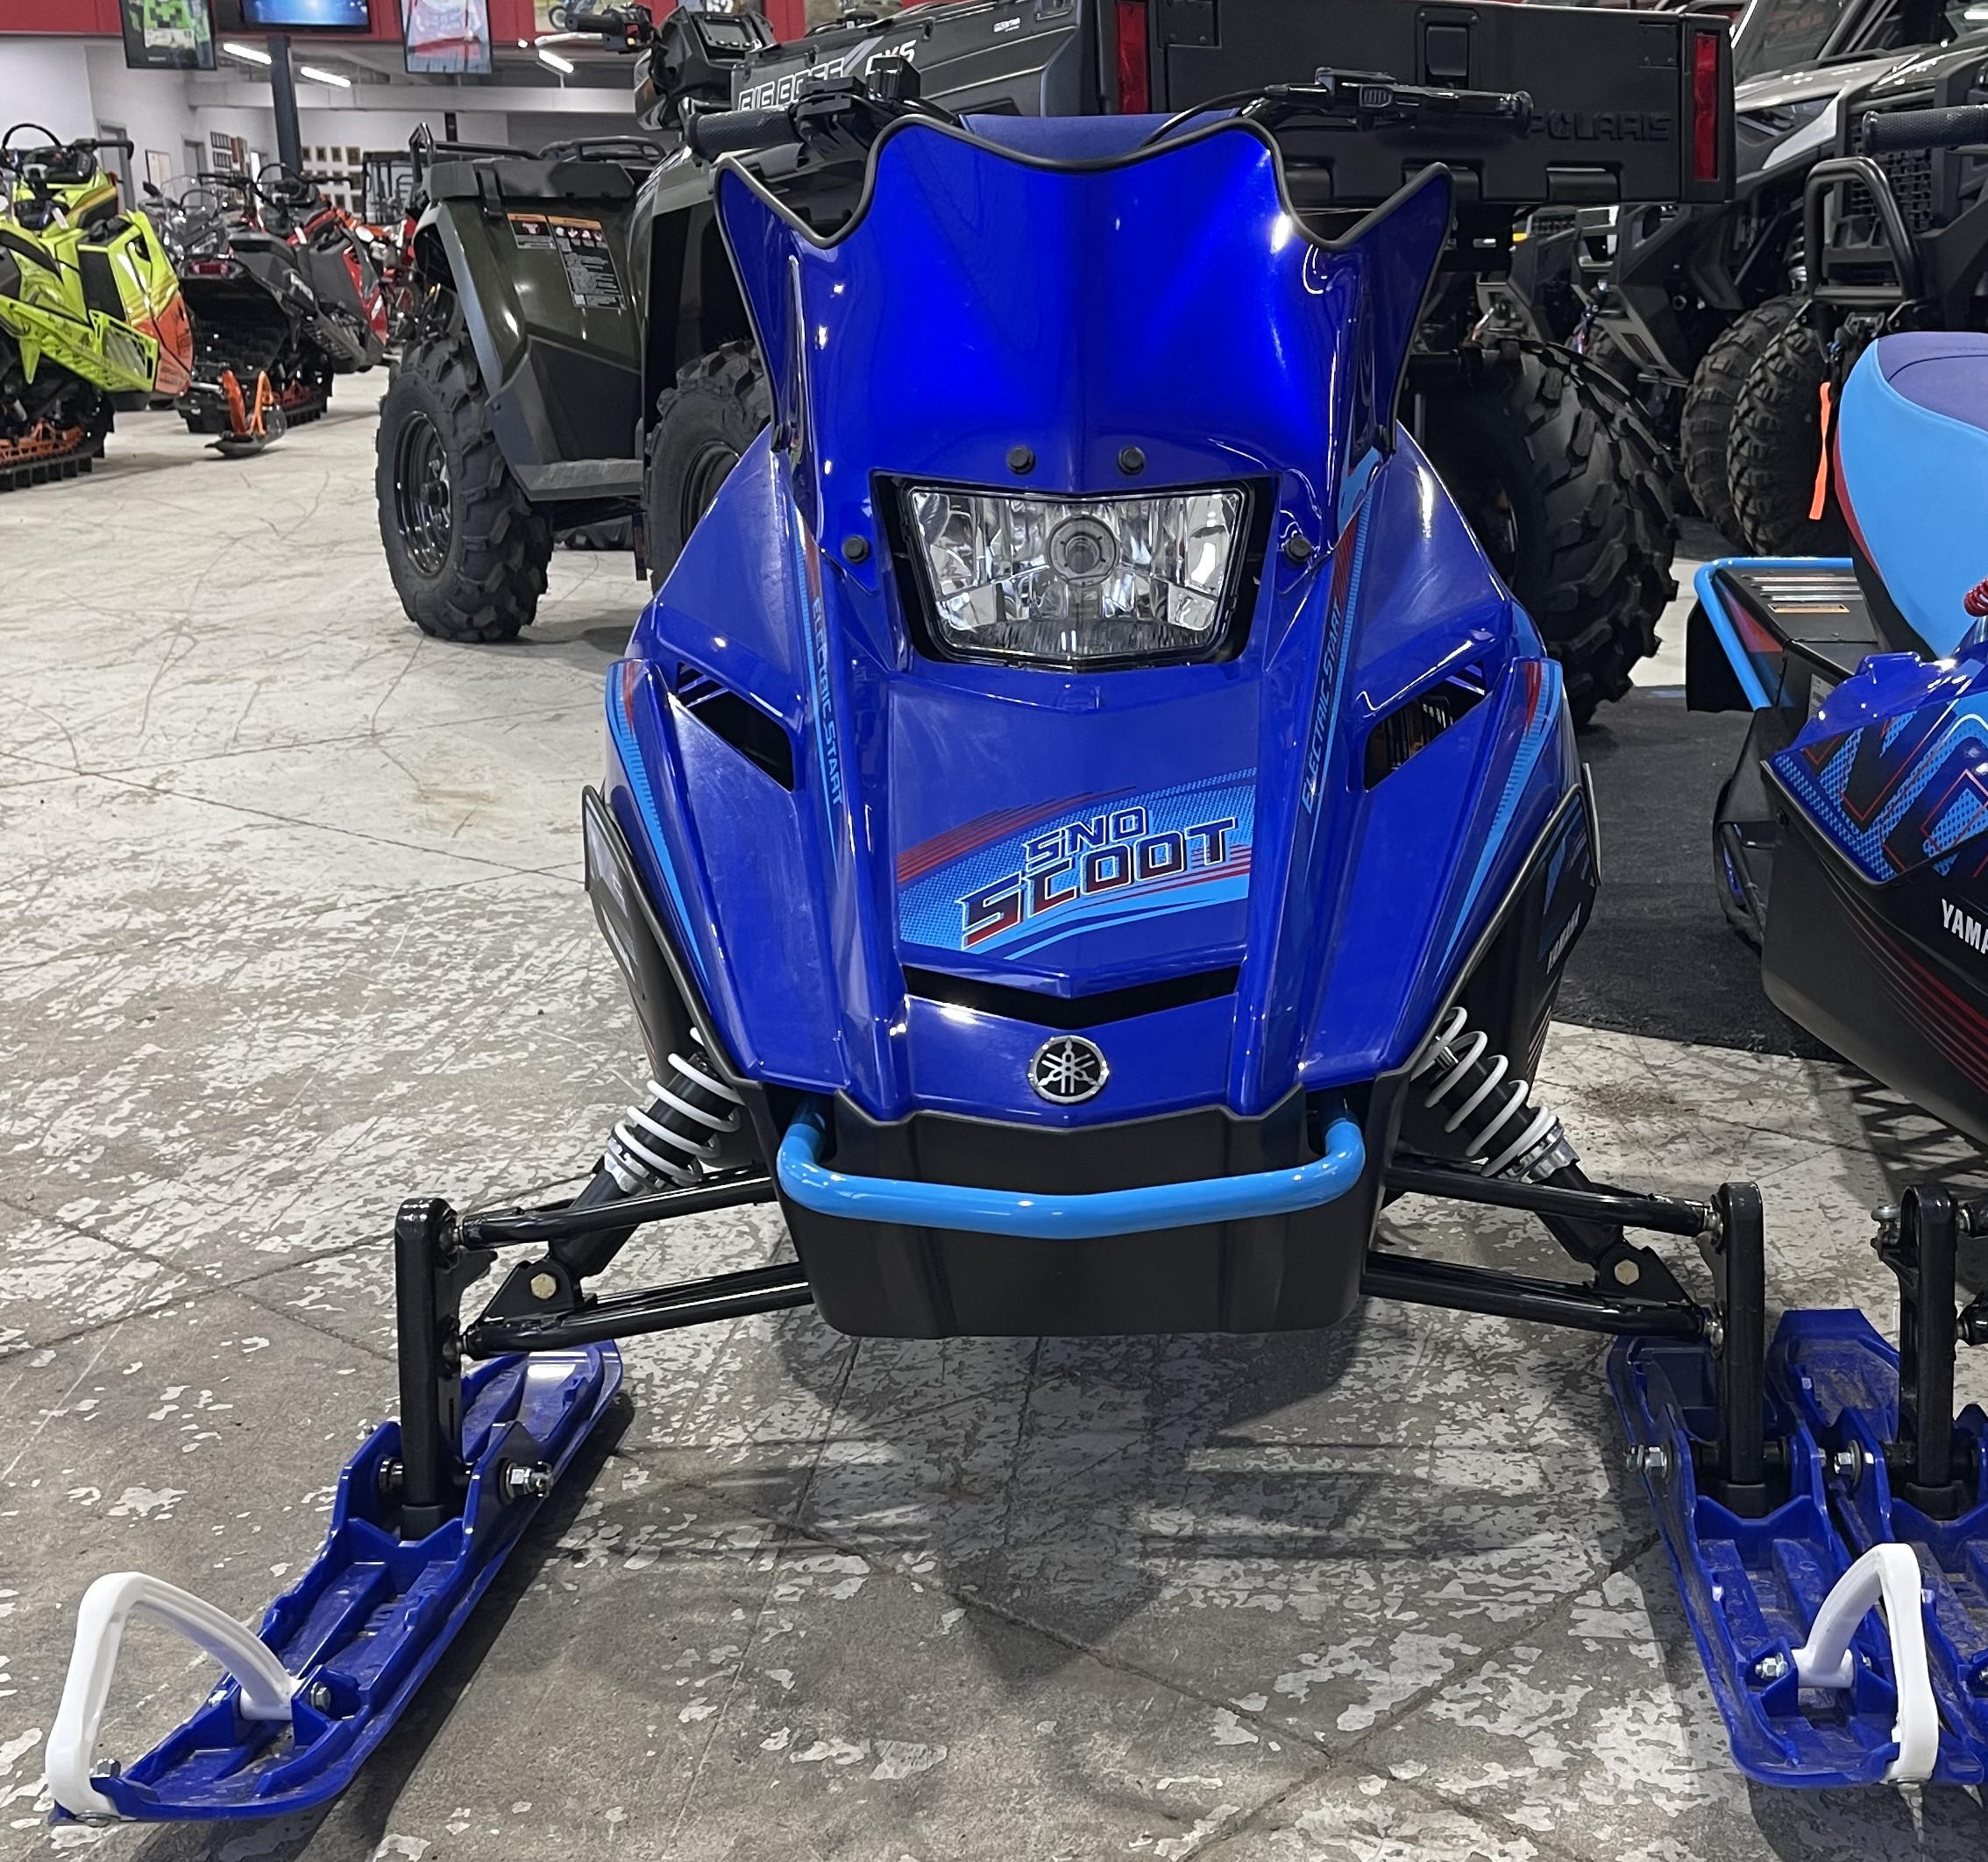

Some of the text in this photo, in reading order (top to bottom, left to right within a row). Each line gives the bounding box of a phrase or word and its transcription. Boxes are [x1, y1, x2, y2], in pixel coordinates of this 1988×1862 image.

[813, 595, 842, 806] ELECTRIC START
[1301, 596, 1341, 815] ELECTRIC START
[955, 816, 1238, 951] SCOOT
[1021, 806, 1148, 872] SNO
